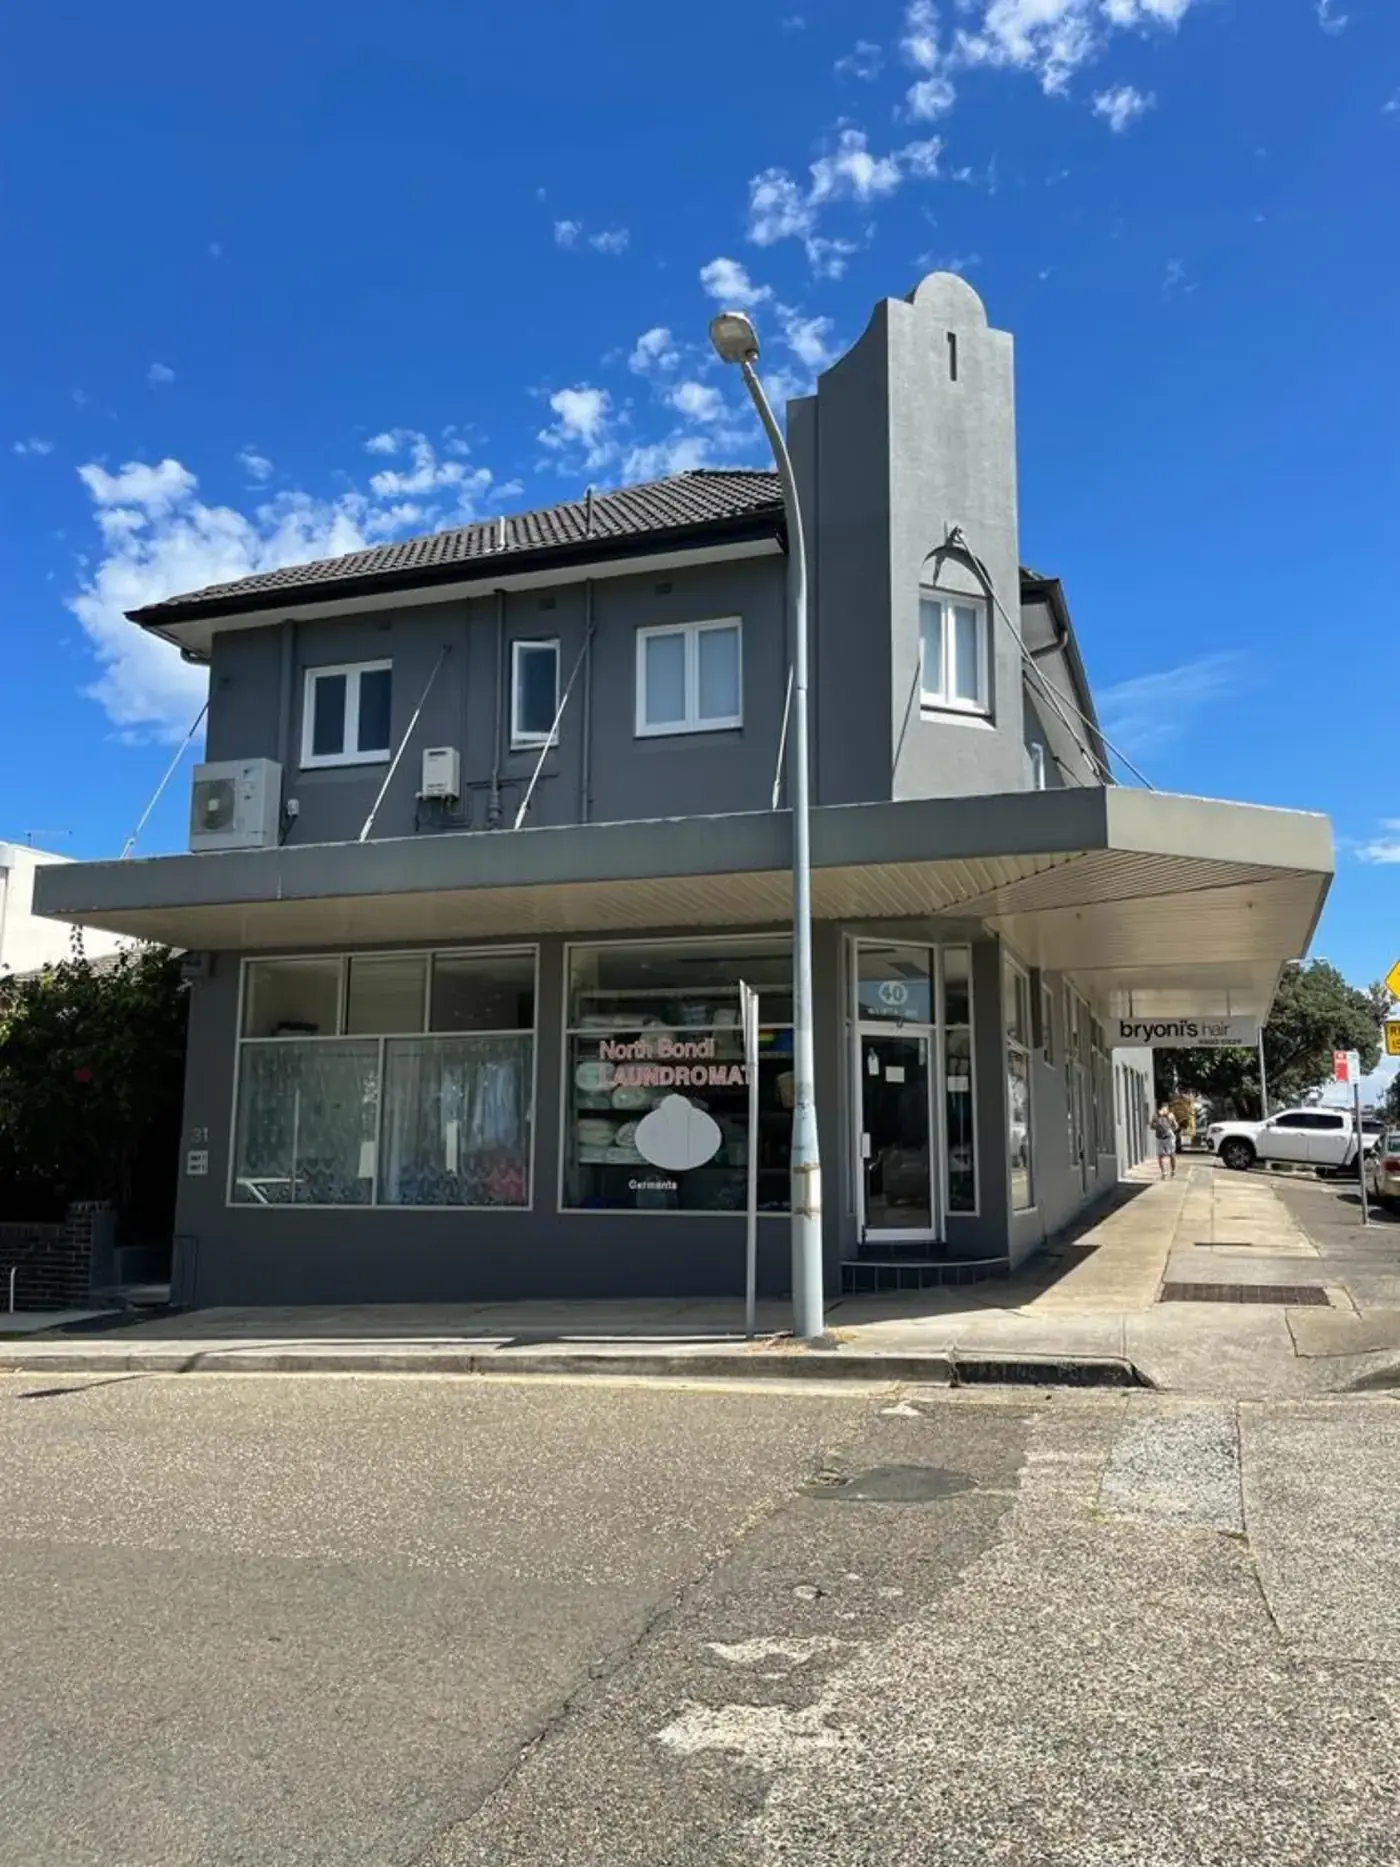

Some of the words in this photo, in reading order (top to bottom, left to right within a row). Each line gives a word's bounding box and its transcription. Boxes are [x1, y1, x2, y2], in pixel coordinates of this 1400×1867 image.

[882, 983, 904, 1001] 40
[1202, 1021, 1231, 1037] hair
[600, 1039, 652, 1059] North
[657, 1037, 715, 1058] Bondi
[190, 1127, 209, 1143] 31
